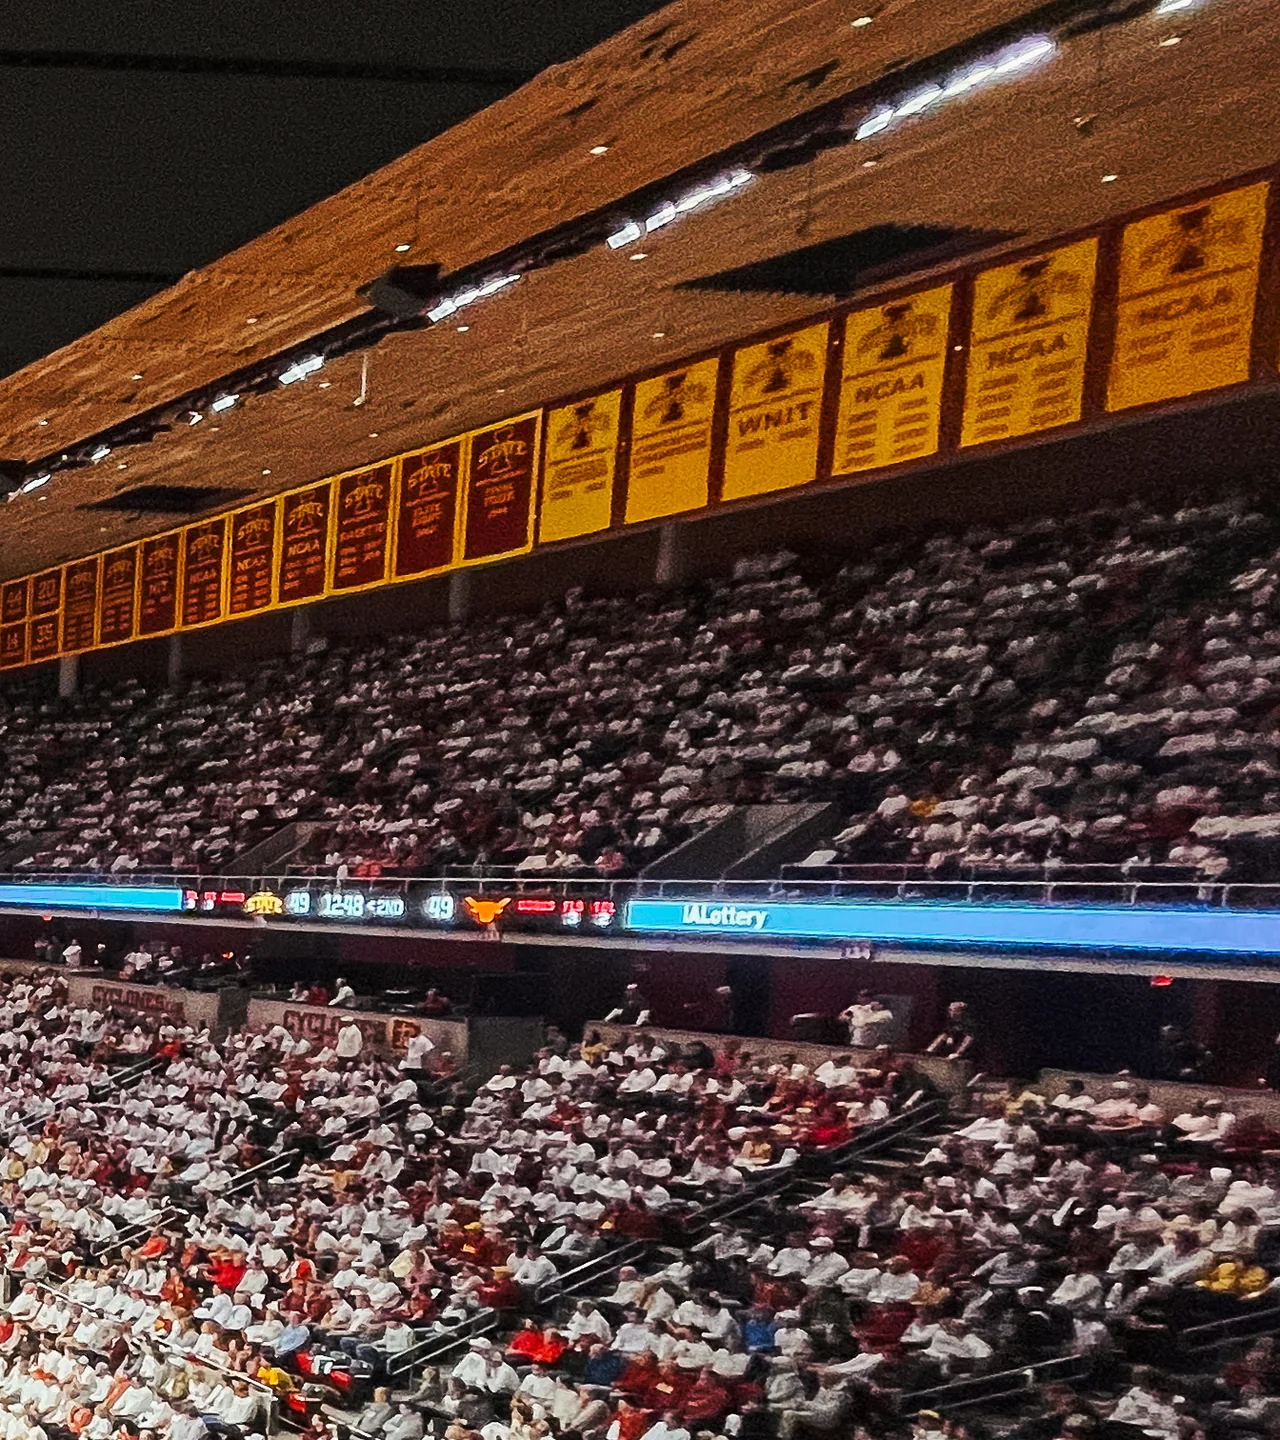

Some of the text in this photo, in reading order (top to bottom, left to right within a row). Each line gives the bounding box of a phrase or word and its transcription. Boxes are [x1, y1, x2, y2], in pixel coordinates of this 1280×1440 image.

[855, 373, 925, 403] NCAA
[738, 401, 813, 437] WNIT
[288, 539, 320, 556] NCAA
[243, 894, 283, 914] STATE
[289, 891, 311, 914] 49
[319, 893, 365, 918] 12:48
[427, 895, 454, 919] 49
[682, 904, 767, 929] IALottery
